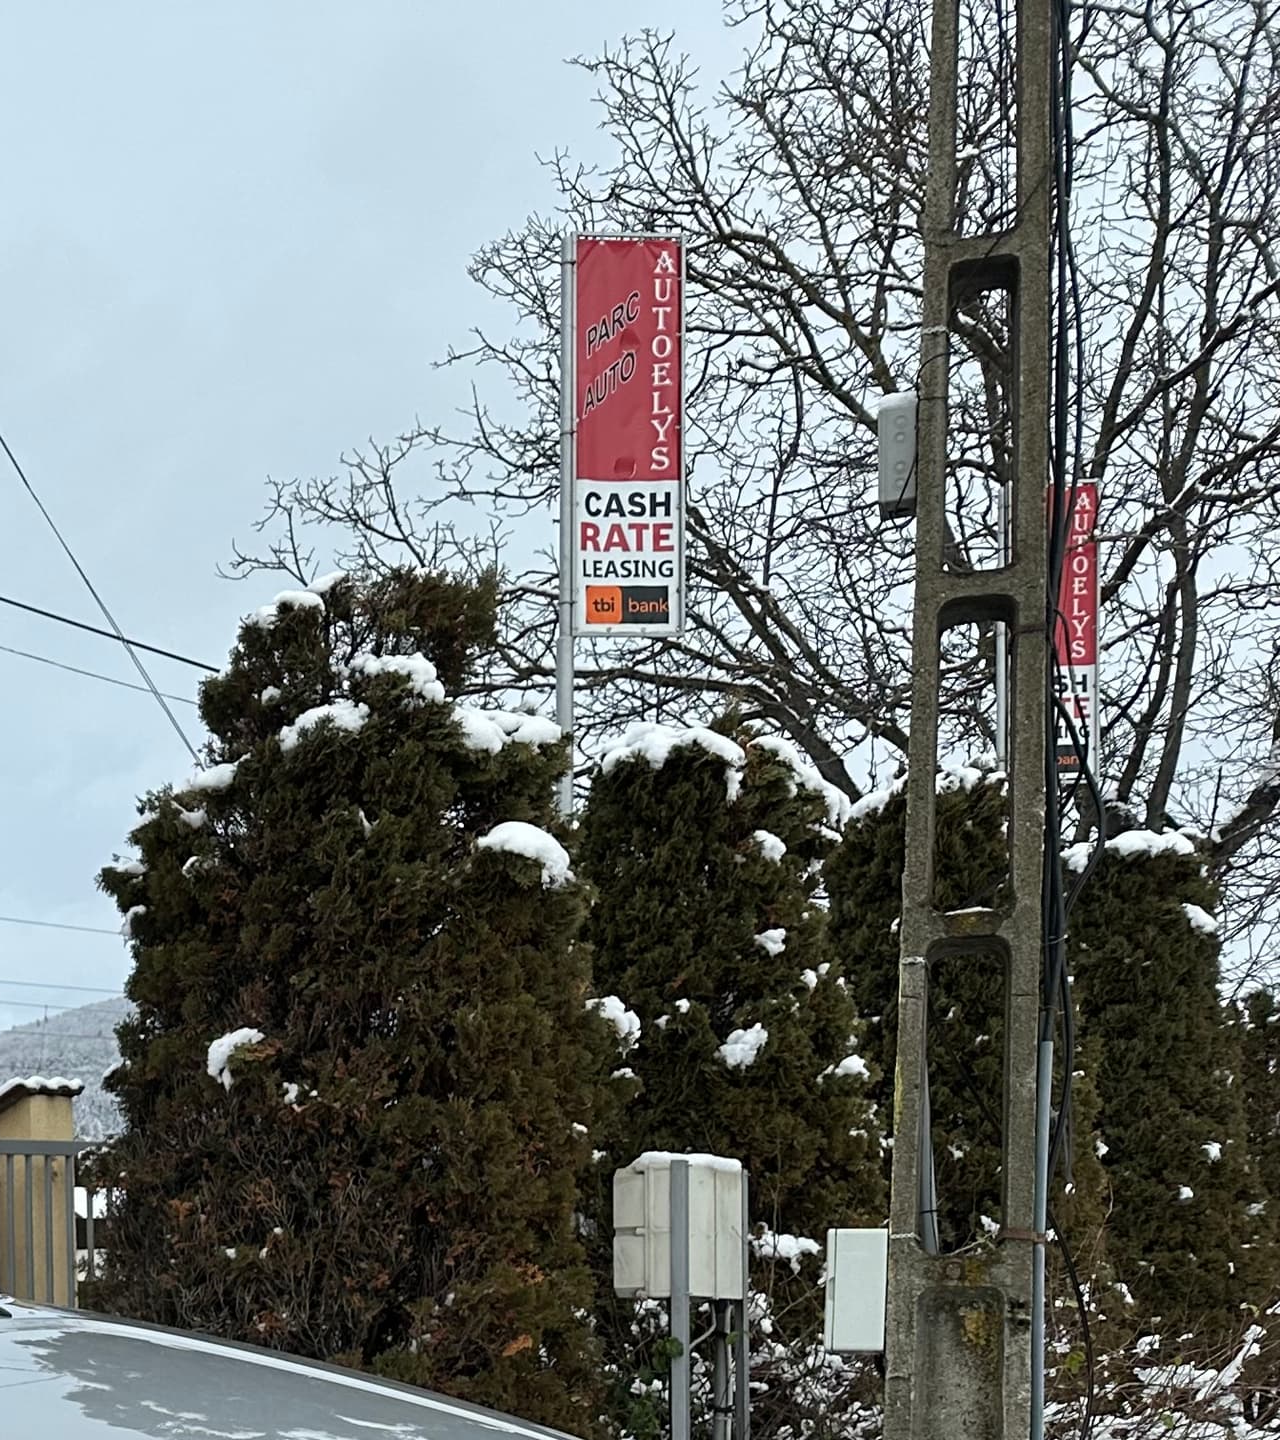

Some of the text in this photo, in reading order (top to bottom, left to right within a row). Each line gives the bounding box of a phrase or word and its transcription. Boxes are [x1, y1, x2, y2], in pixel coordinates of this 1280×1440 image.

[586, 290, 640, 358] PARC
[583, 349, 637, 419] AUTO
[650, 250, 677, 472] AUTOELYS
[585, 491, 671, 518] CASH
[581, 522, 675, 553] RATE
[582, 560, 675, 579] LEASING
[1071, 492, 1091, 659] AUTOELYS
[592, 597, 668, 613] tbi bank
